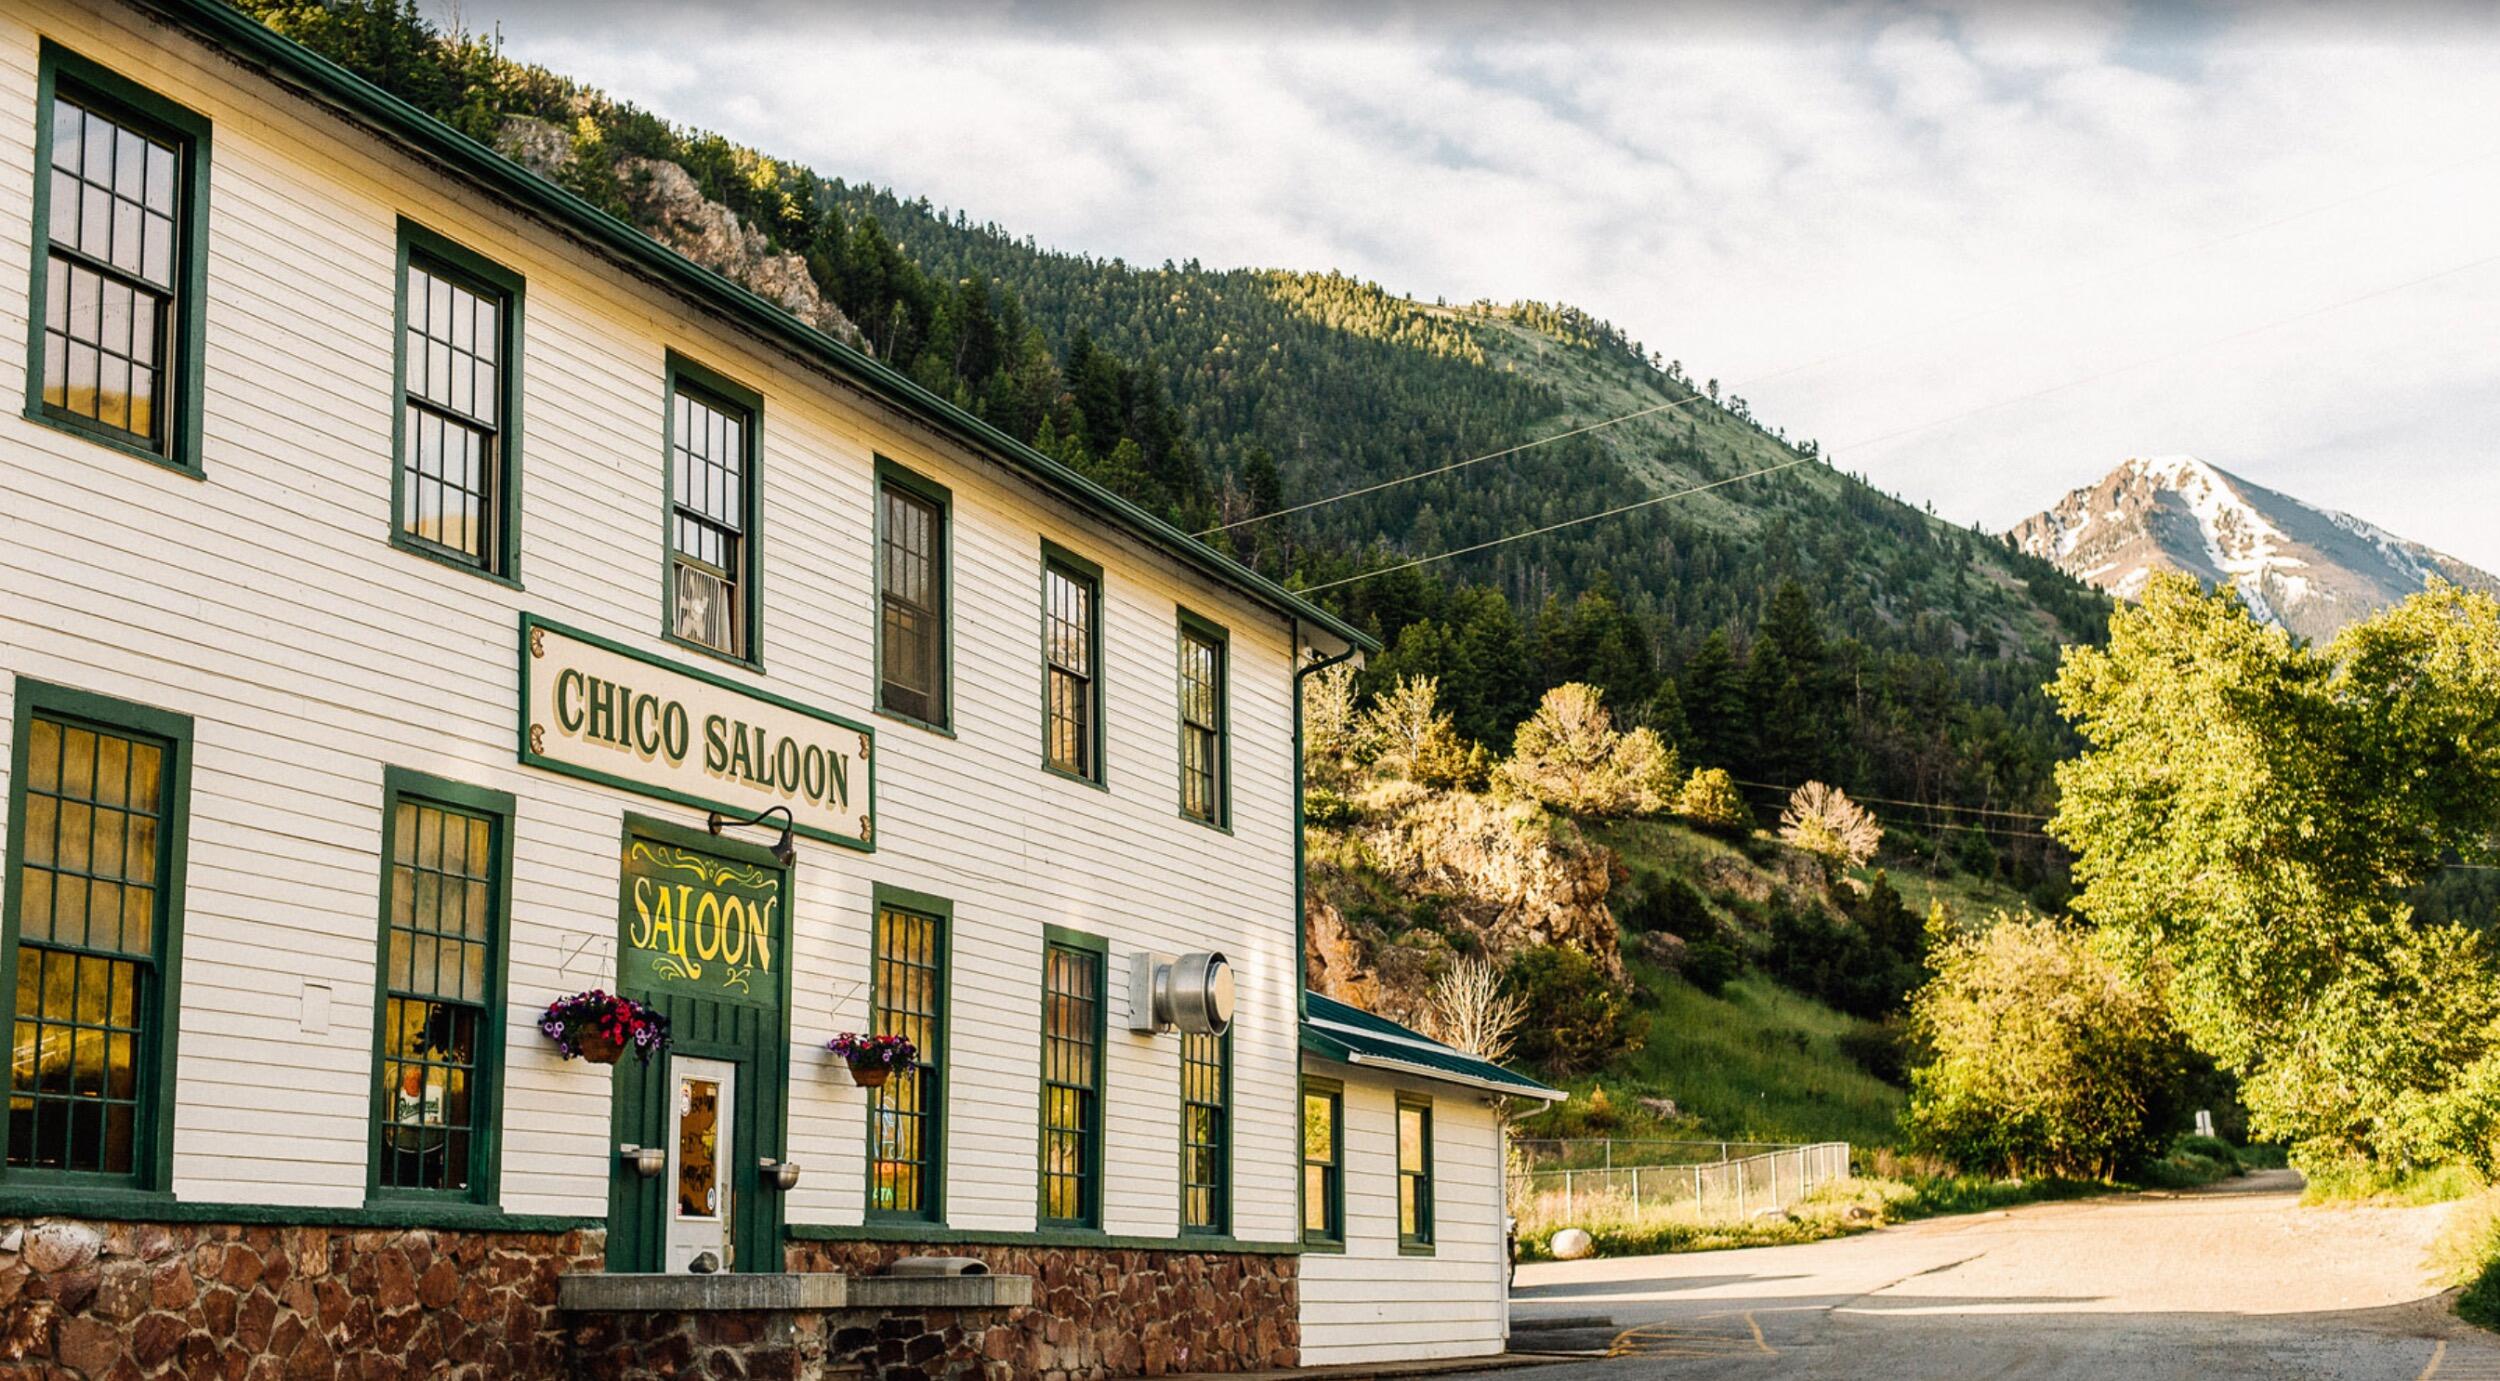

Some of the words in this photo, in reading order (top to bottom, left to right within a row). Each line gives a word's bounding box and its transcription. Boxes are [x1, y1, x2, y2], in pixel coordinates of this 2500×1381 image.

[554, 668, 689, 764] CHICO
[704, 714, 849, 808] SALOON
[630, 876, 778, 980] SALOON
